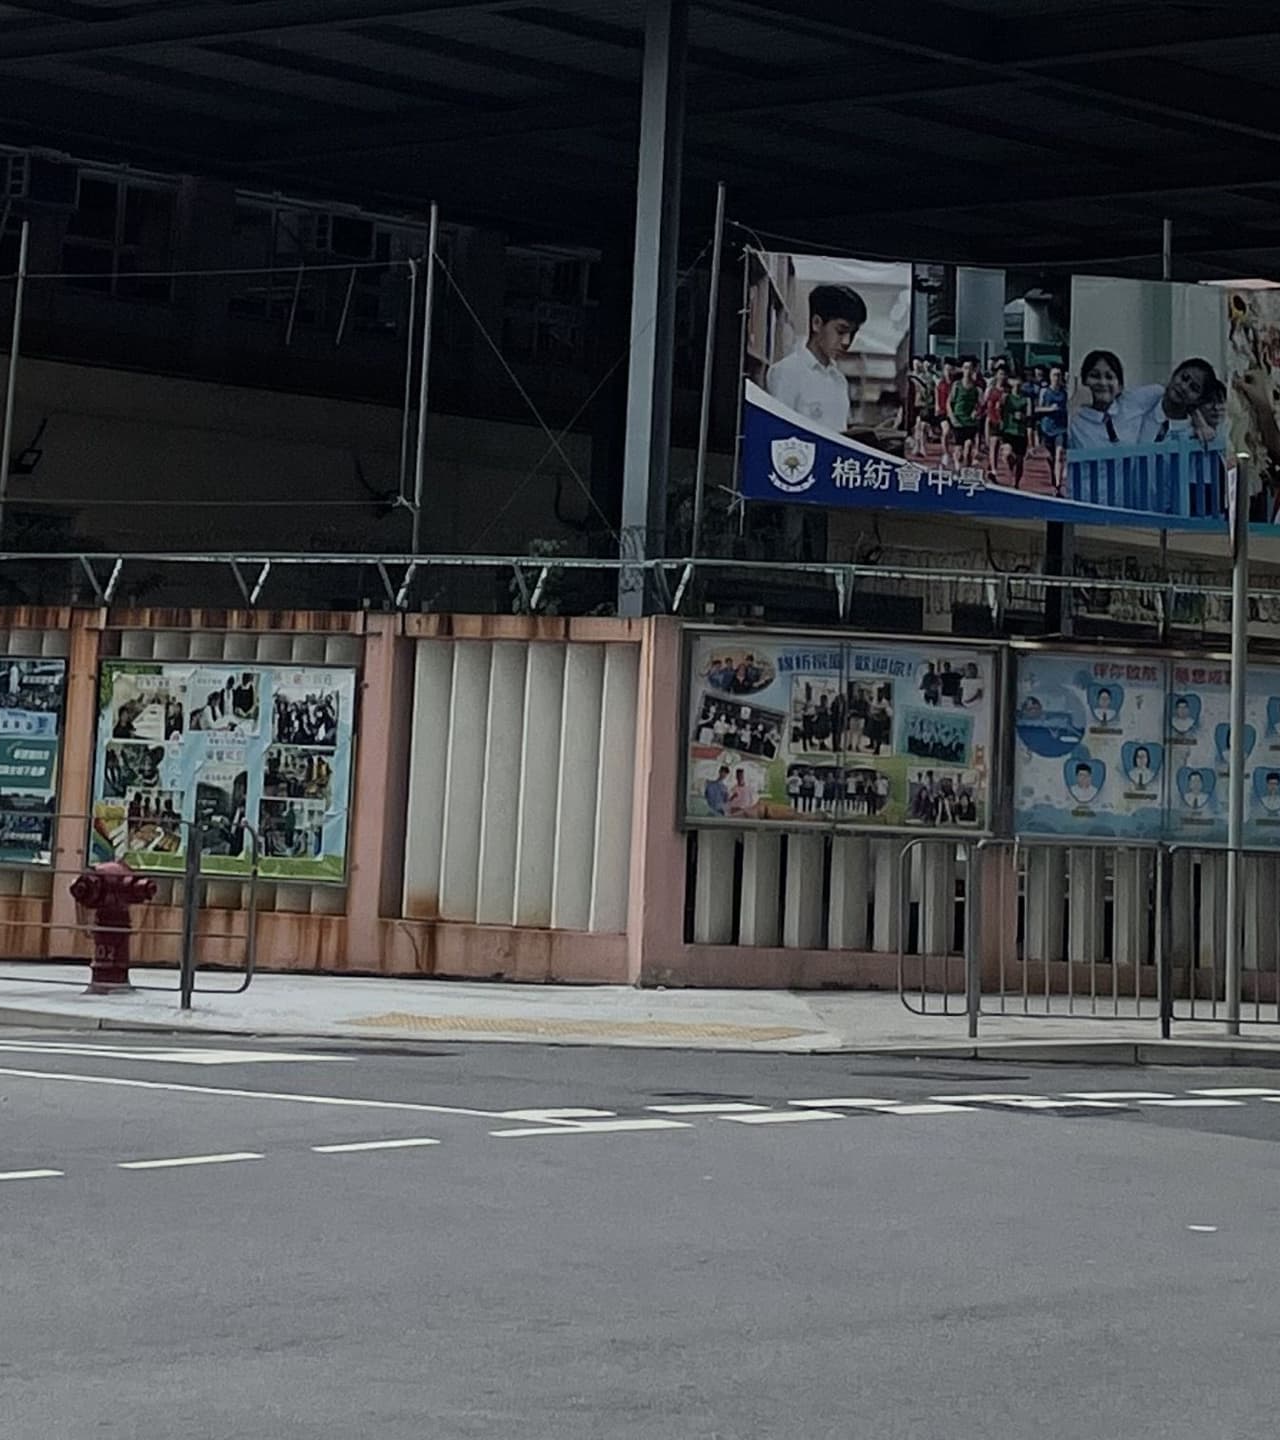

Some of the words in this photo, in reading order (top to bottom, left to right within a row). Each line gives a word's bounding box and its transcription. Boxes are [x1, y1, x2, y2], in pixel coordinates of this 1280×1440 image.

[830, 455, 987, 498] 棉紡會中學
